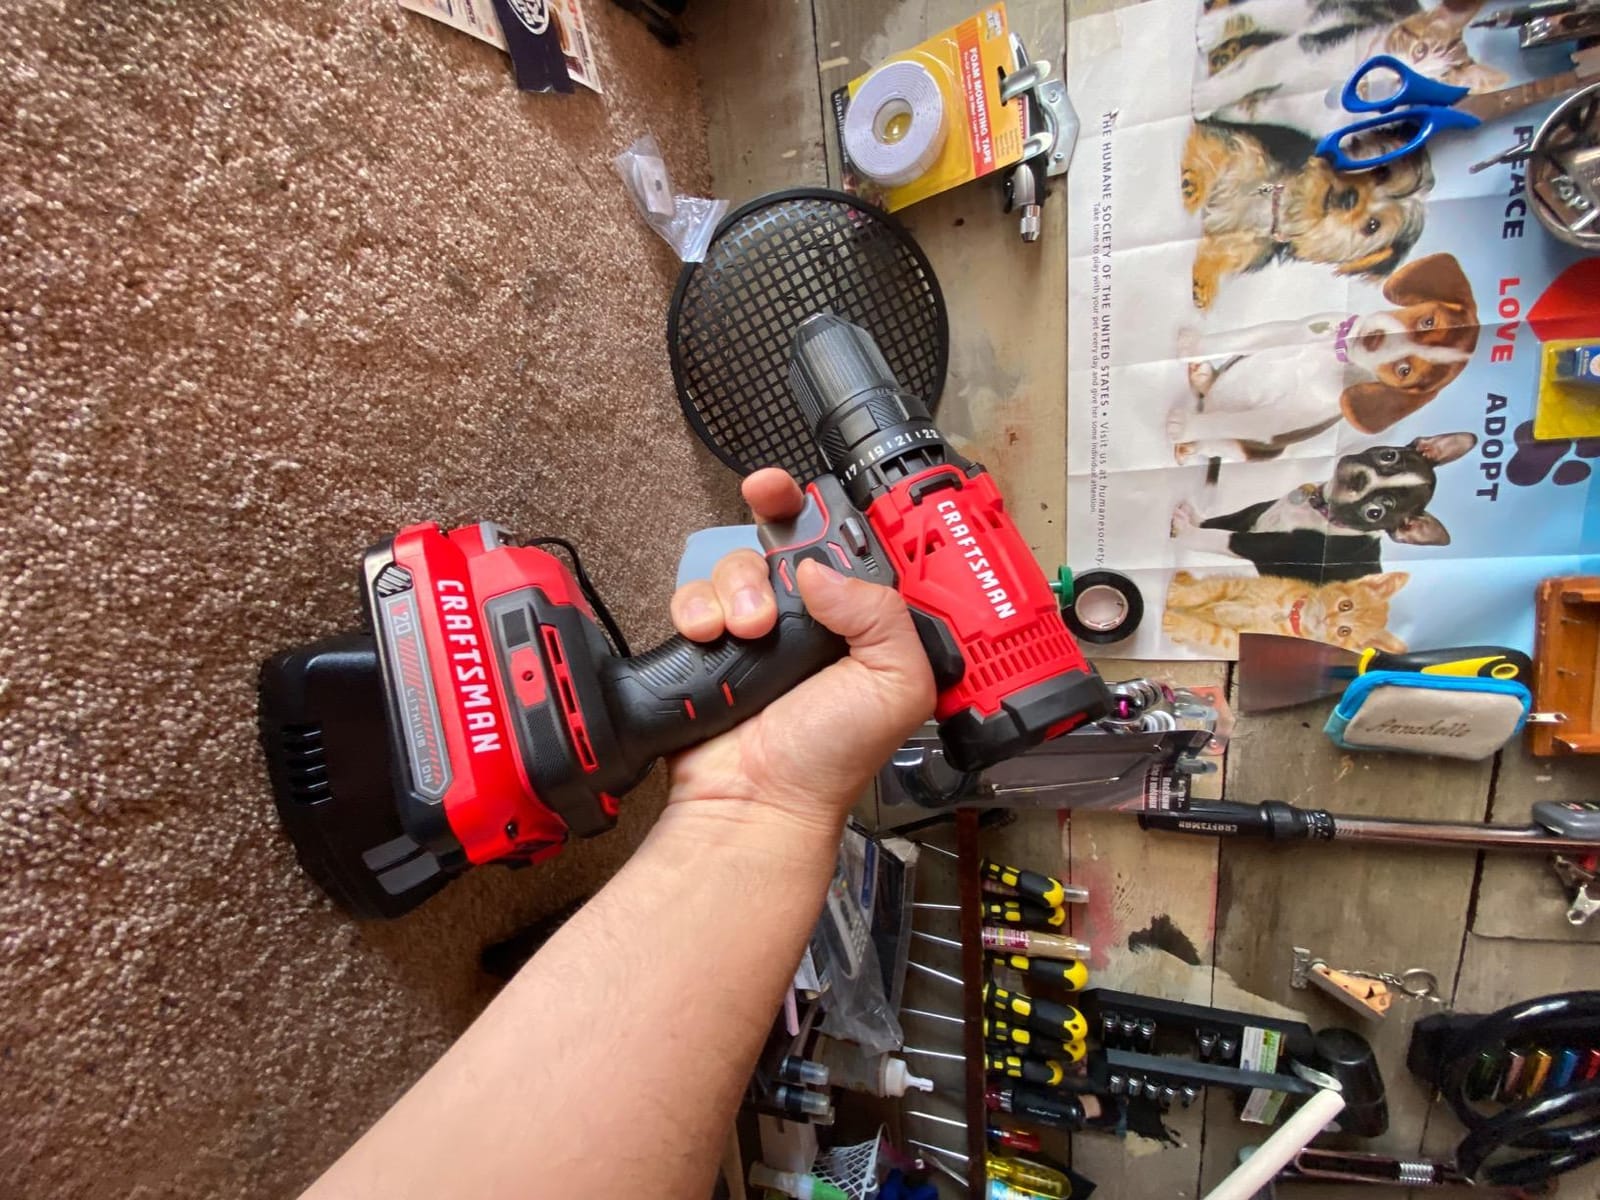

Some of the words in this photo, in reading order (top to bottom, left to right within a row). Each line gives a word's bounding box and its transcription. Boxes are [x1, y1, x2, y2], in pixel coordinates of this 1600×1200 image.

[969, 47, 980, 79] FOAM
[974, 80, 989, 136] MOUNTING
[1102, 112, 1112, 137] THE
[982, 137, 992, 164] TAPE
[1102, 142, 1112, 200] HUMANE
[1502, 126, 1534, 239] PEACE
[1102, 205, 1112, 258] SOCIETY
[1092, 244, 1100, 254] to
[1091, 256, 1101, 273] play
[1102, 264, 1111, 280] OF
[1092, 275, 1100, 294] with
[1101, 285, 1111, 309] THE
[1091, 295, 1099, 313] your
[1091, 316, 1099, 330] pet
[1490, 277, 1521, 363] LOVE
[1101, 314, 1111, 360] UNITED
[1090, 355, 1099, 370] day
[1091, 371, 1099, 386] and
[1100, 365, 1110, 406] STATES
[1090, 389, 1099, 403] give
[1100, 422, 1109, 447] Visit
[1476, 392, 1508, 502] ADOPT
[845, 463, 857, 480] 17
[868, 445, 885, 460] 19
[895, 432, 912, 446] 21
[1090, 442, 1098, 478] individual
[1099, 452, 1107, 464] us
[1099, 469, 1108, 480] at
[937, 500, 1017, 619] CRAFTSMAN
[437, 579, 501, 754] CRAFTSMAN
[406, 687, 426, 748] LITHIUM
[421, 758, 433, 784] ION
[1179, 820, 1238, 832] CRAFTSMAN
